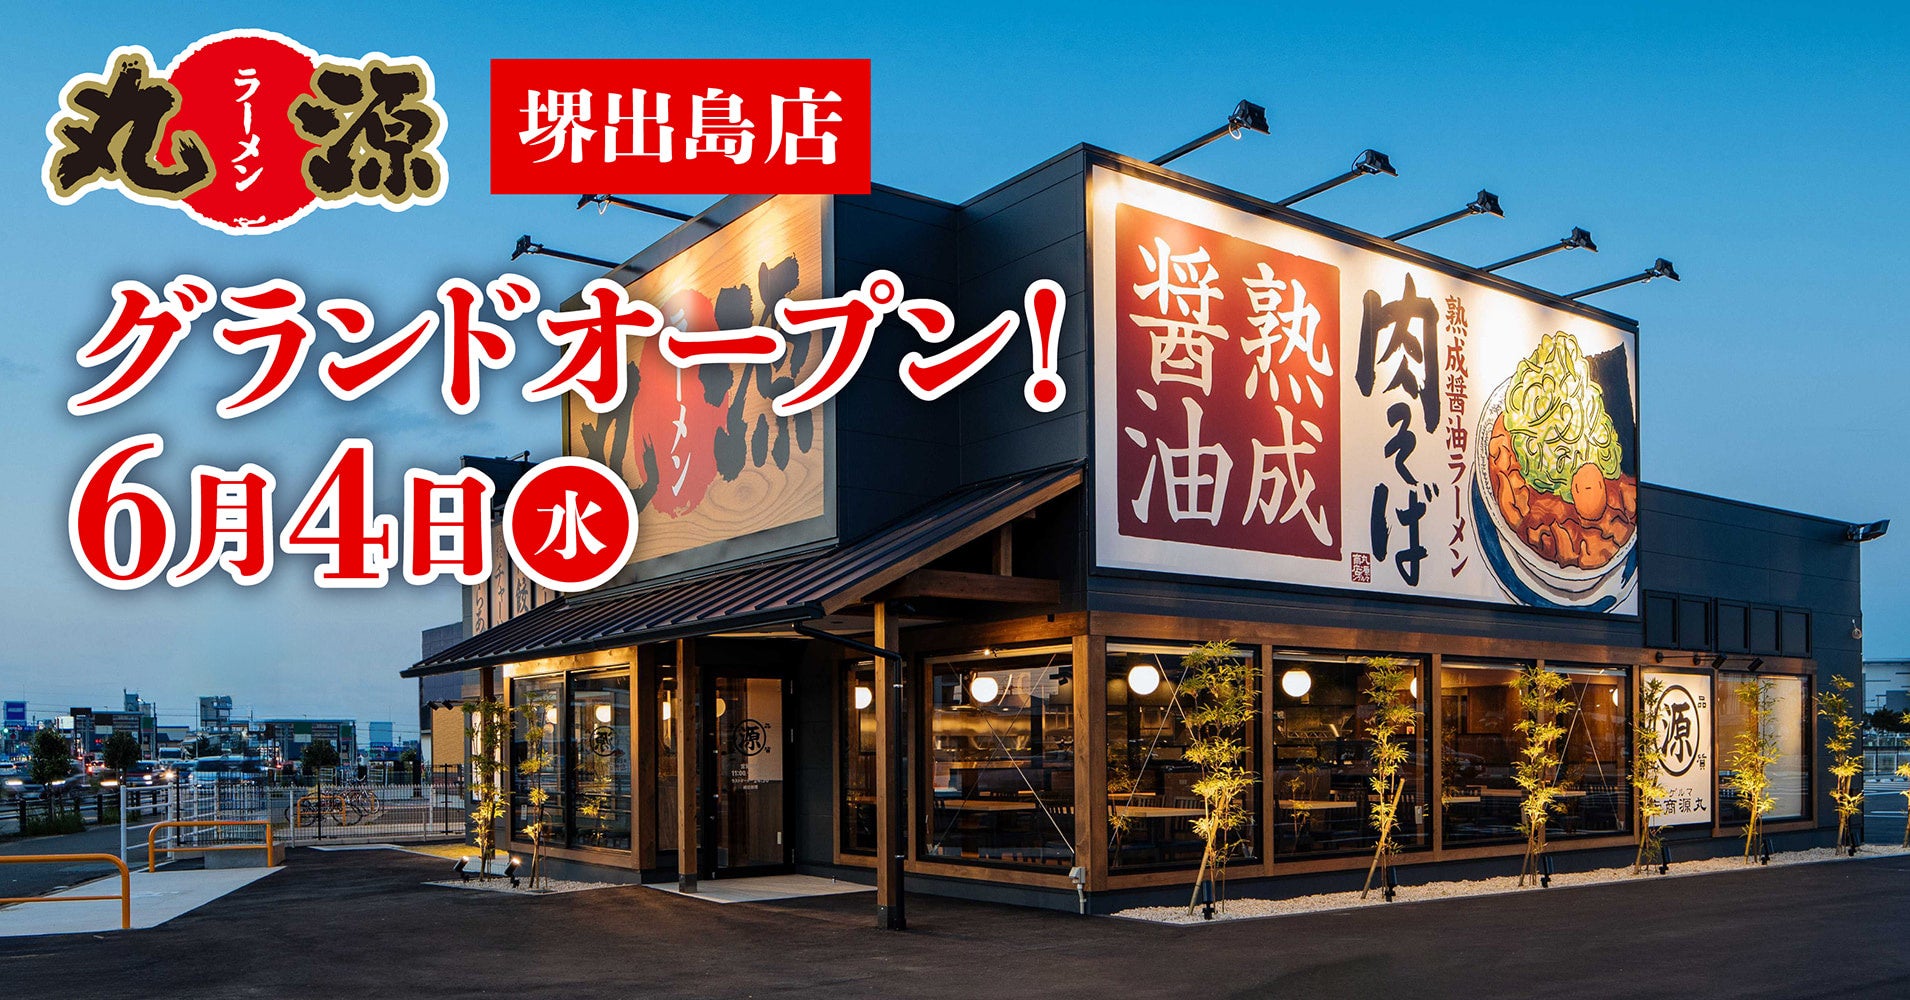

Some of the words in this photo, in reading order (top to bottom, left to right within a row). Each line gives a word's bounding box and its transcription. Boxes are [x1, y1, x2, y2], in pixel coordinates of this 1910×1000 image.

[1124, 236, 1234, 528] 醤油
[1239, 261, 1334, 547] 熟成
[1354, 272, 1440, 588] 肉そば
[1444, 294, 1470, 579] 熟成醤油ラーメン
[1661, 700, 1693, 764] 源
